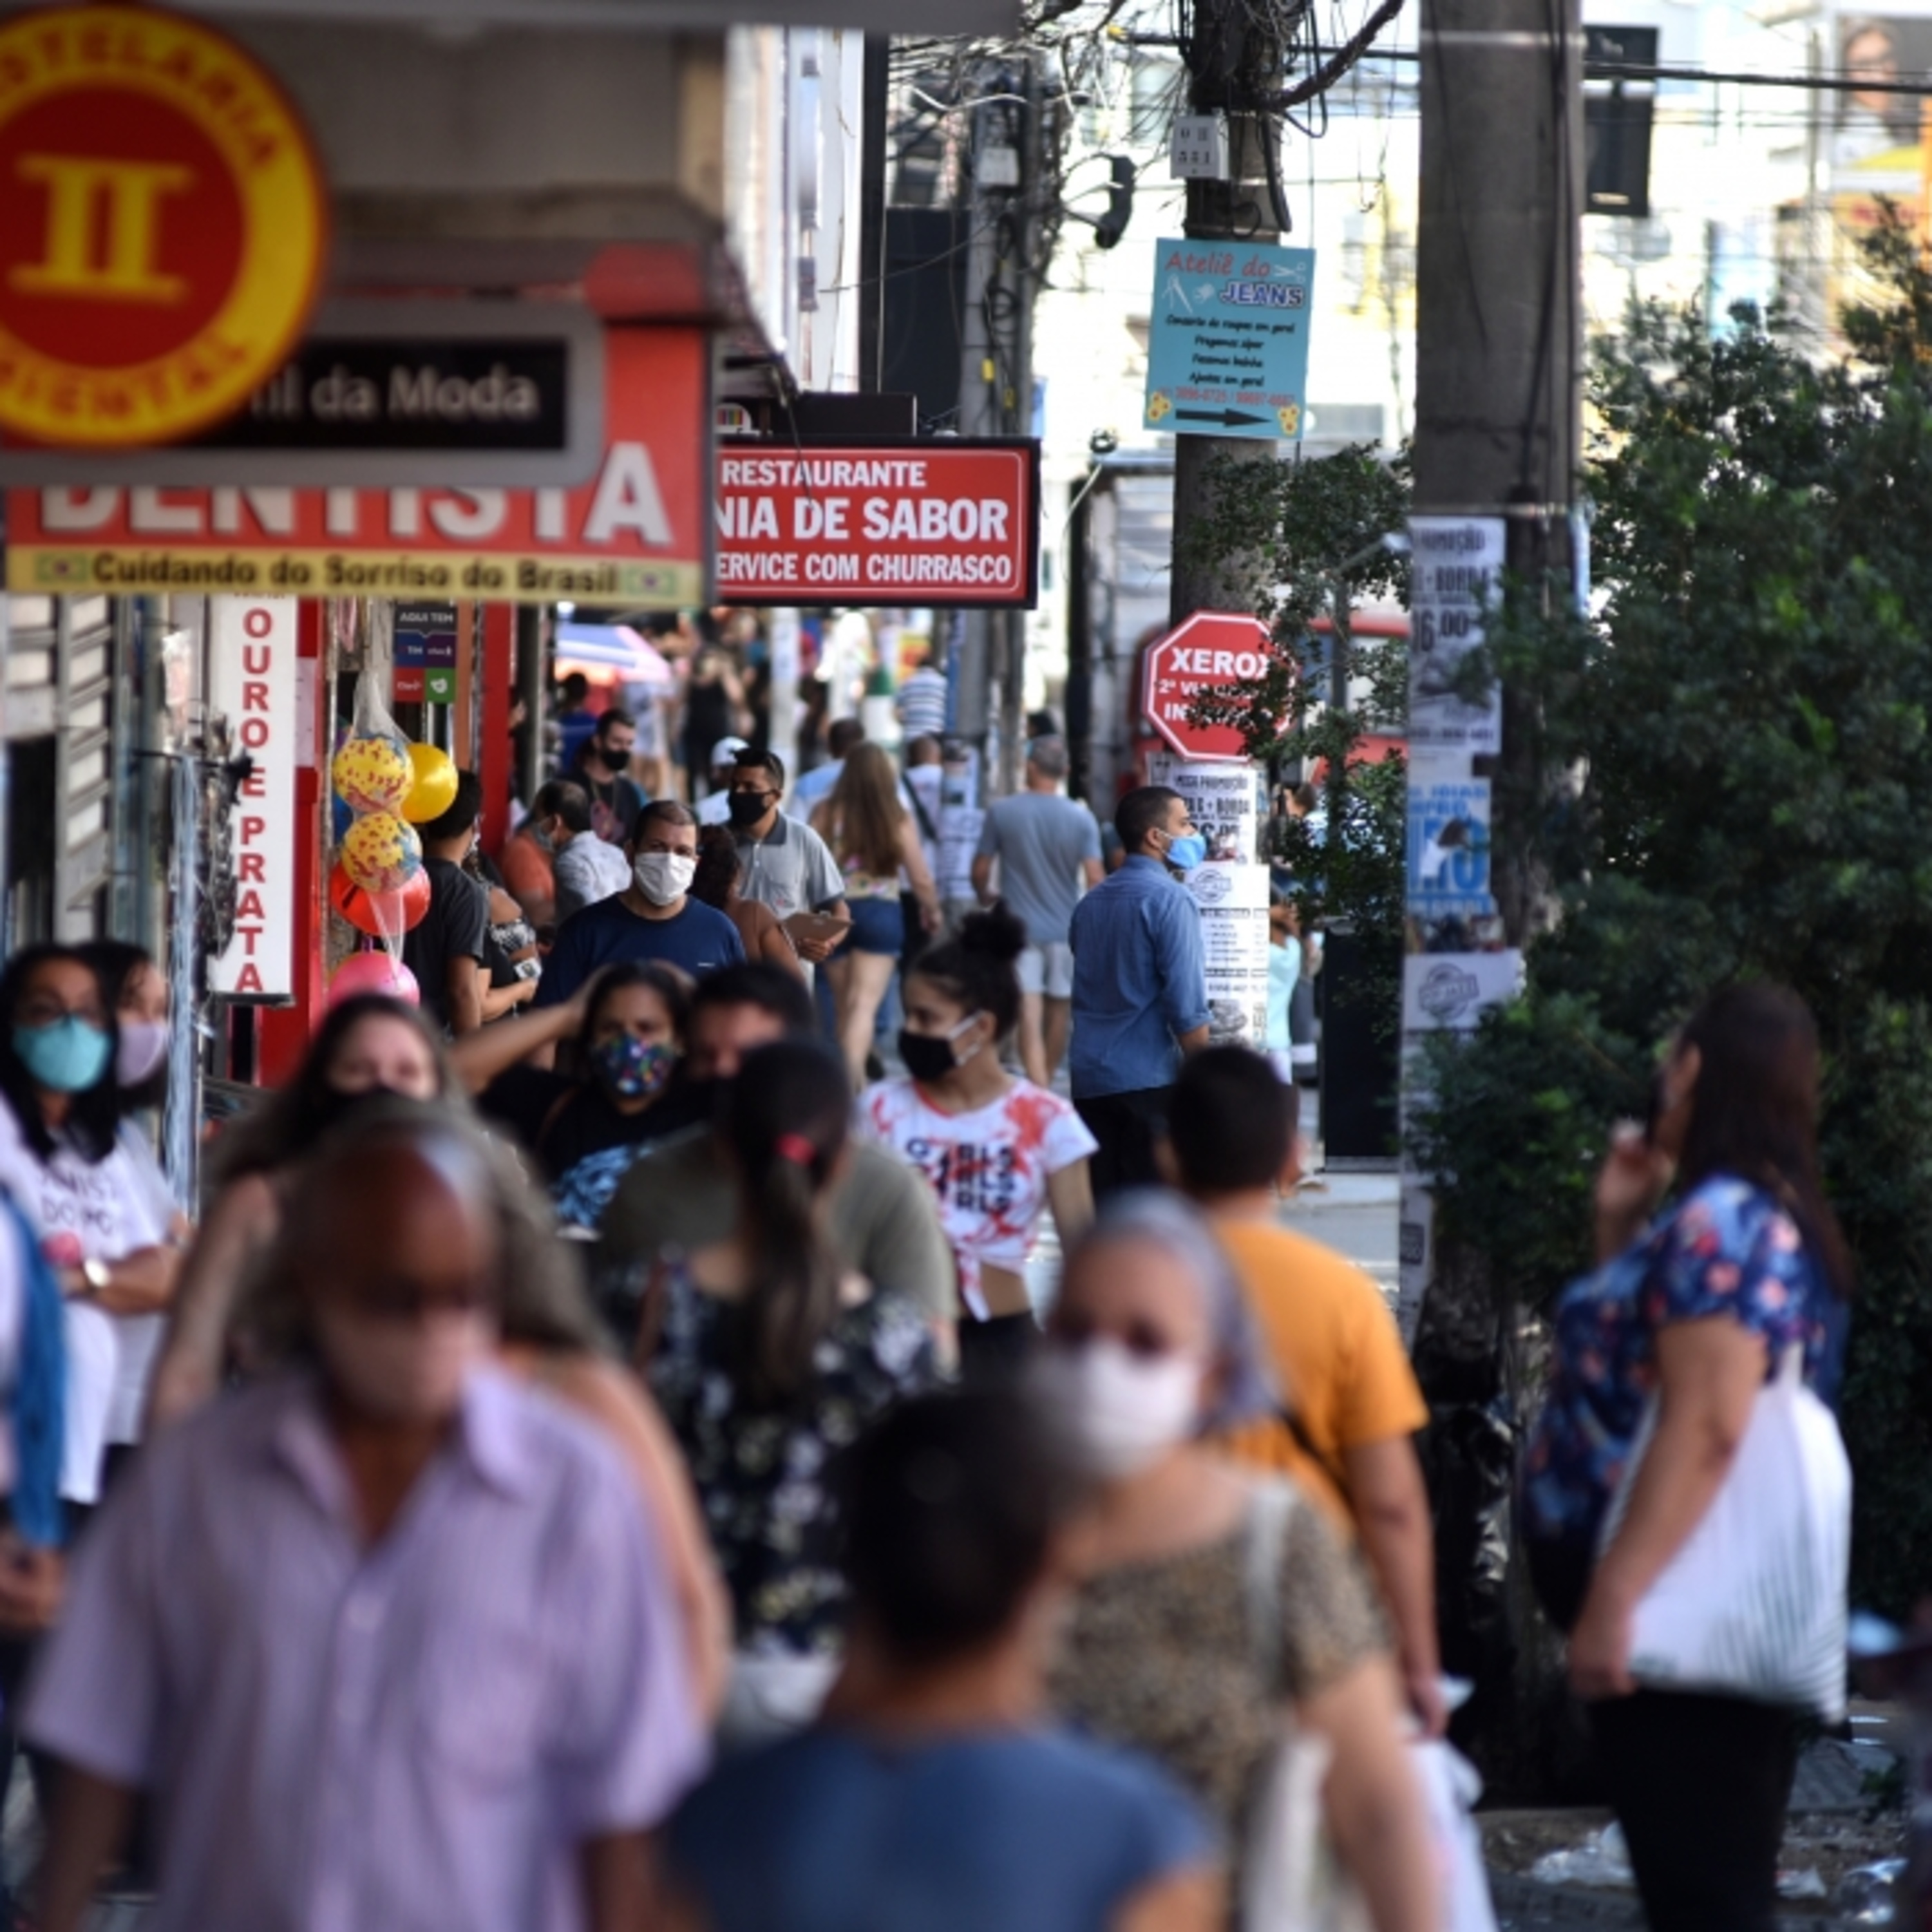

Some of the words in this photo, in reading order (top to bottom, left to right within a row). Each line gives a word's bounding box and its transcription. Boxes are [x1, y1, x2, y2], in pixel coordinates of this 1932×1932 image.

[1166, 252, 1233, 276] Ateliê
[1242, 254, 1270, 278] do
[1220, 281, 1303, 308] JEANS
[310, 363, 381, 421] da
[389, 361, 540, 421] Moda
[722, 460, 927, 488] RESTAURANTE
[795, 497, 850, 540] DE
[862, 497, 1009, 541] SABOR
[93, 553, 256, 586] Cuidando
[269, 556, 310, 587] do
[323, 555, 448, 590] Sorriso
[462, 560, 504, 589] do
[517, 560, 619, 596] Brasil
[805, 554, 859, 582] COM
[866, 554, 1012, 583] CHURRASCO
[240, 609, 272, 748] OURO
[236, 816, 265, 992] PRATA
